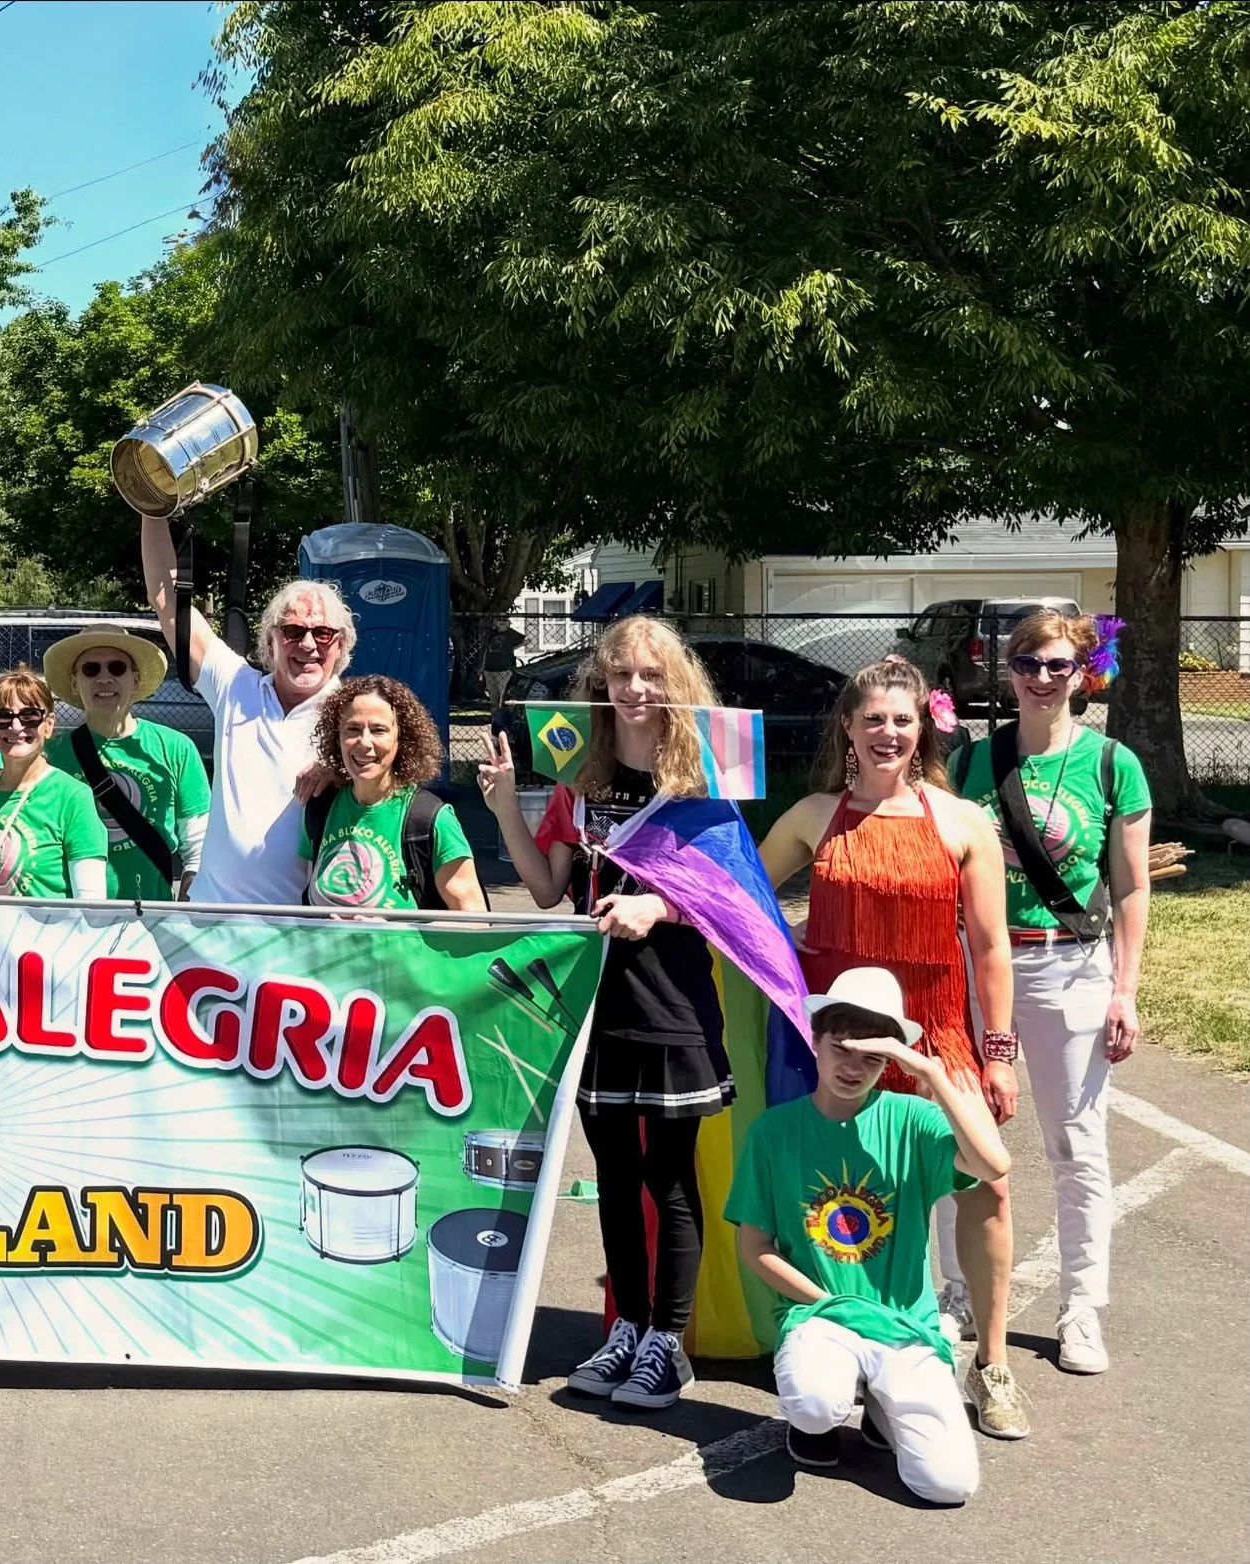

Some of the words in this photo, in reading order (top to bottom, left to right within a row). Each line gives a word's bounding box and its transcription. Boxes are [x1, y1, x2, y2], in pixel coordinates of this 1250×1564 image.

[127, 765, 158, 803] ALEGRIA
[338, 826, 374, 839] BLOCO
[373, 834, 402, 883] ALEGRIA
[1058, 844, 1087, 873] GON
